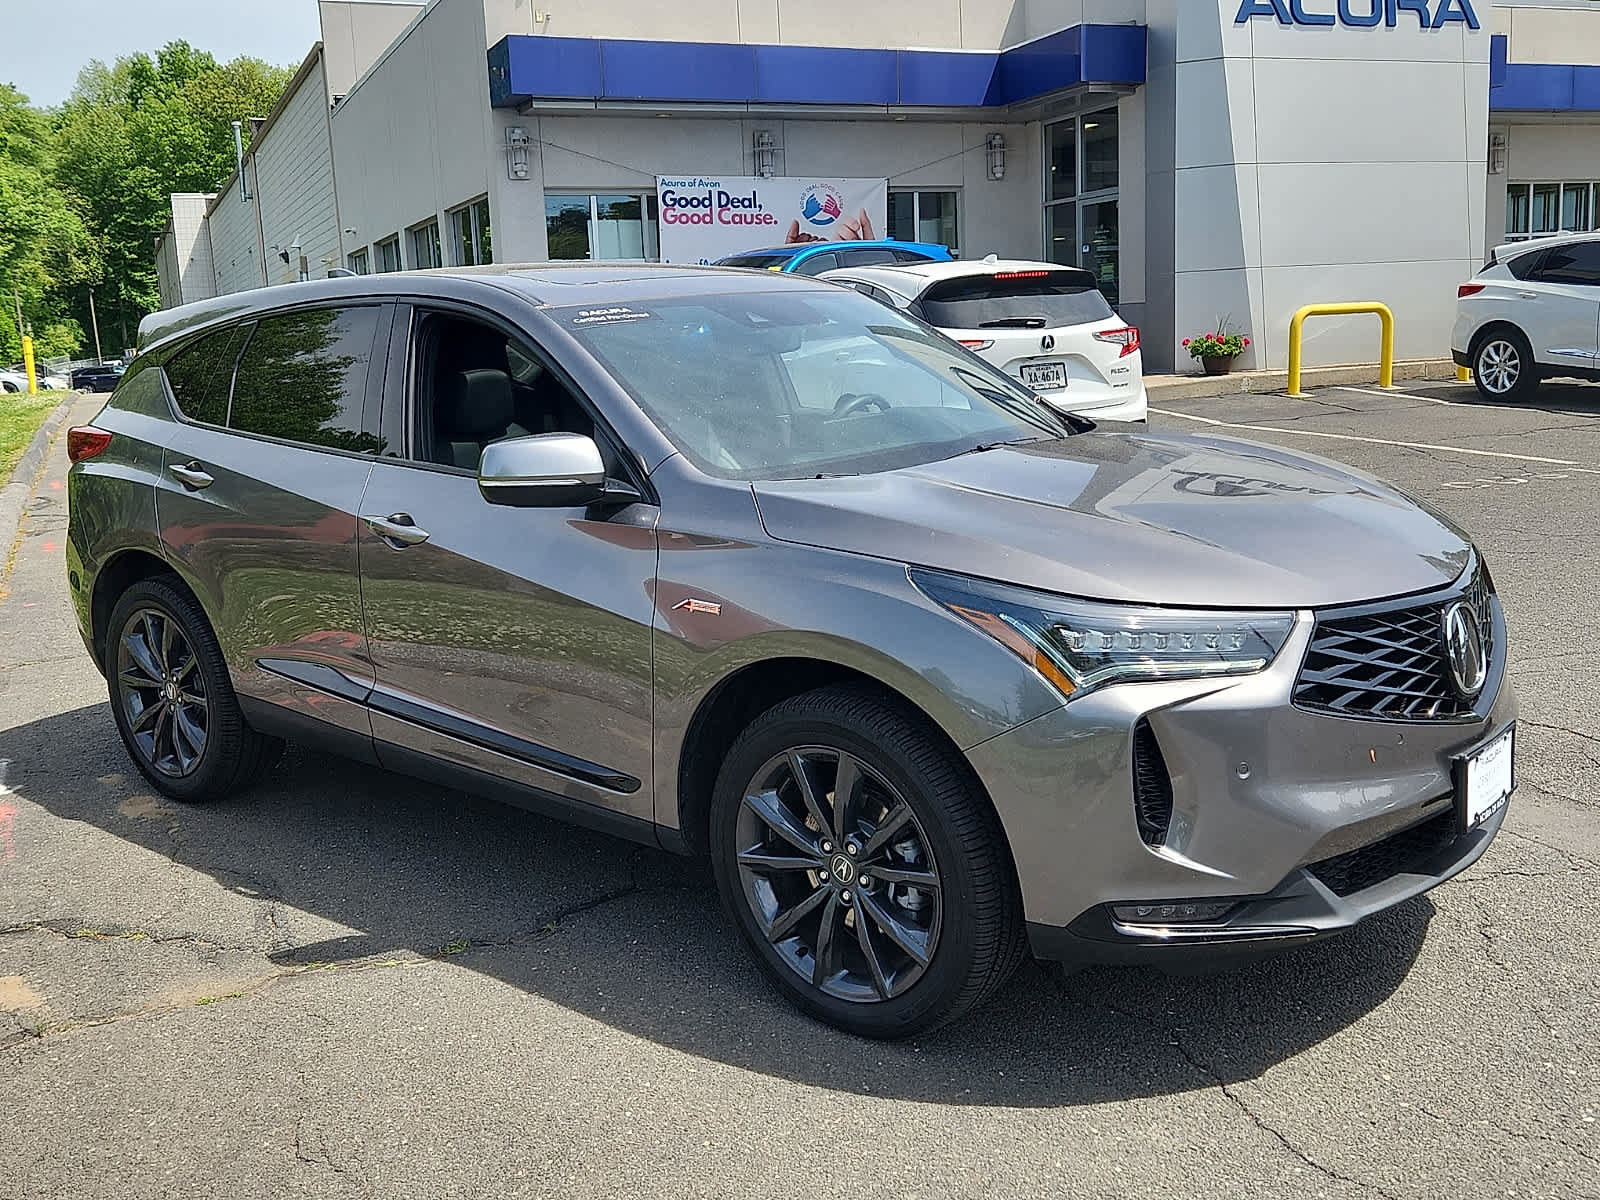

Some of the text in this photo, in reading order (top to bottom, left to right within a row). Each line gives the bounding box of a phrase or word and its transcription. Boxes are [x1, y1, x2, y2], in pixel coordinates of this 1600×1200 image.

[660, 178, 721, 188] Acura of Avon
[661, 190, 763, 212] Good Deal,
[662, 207, 778, 226] Good Cause.
